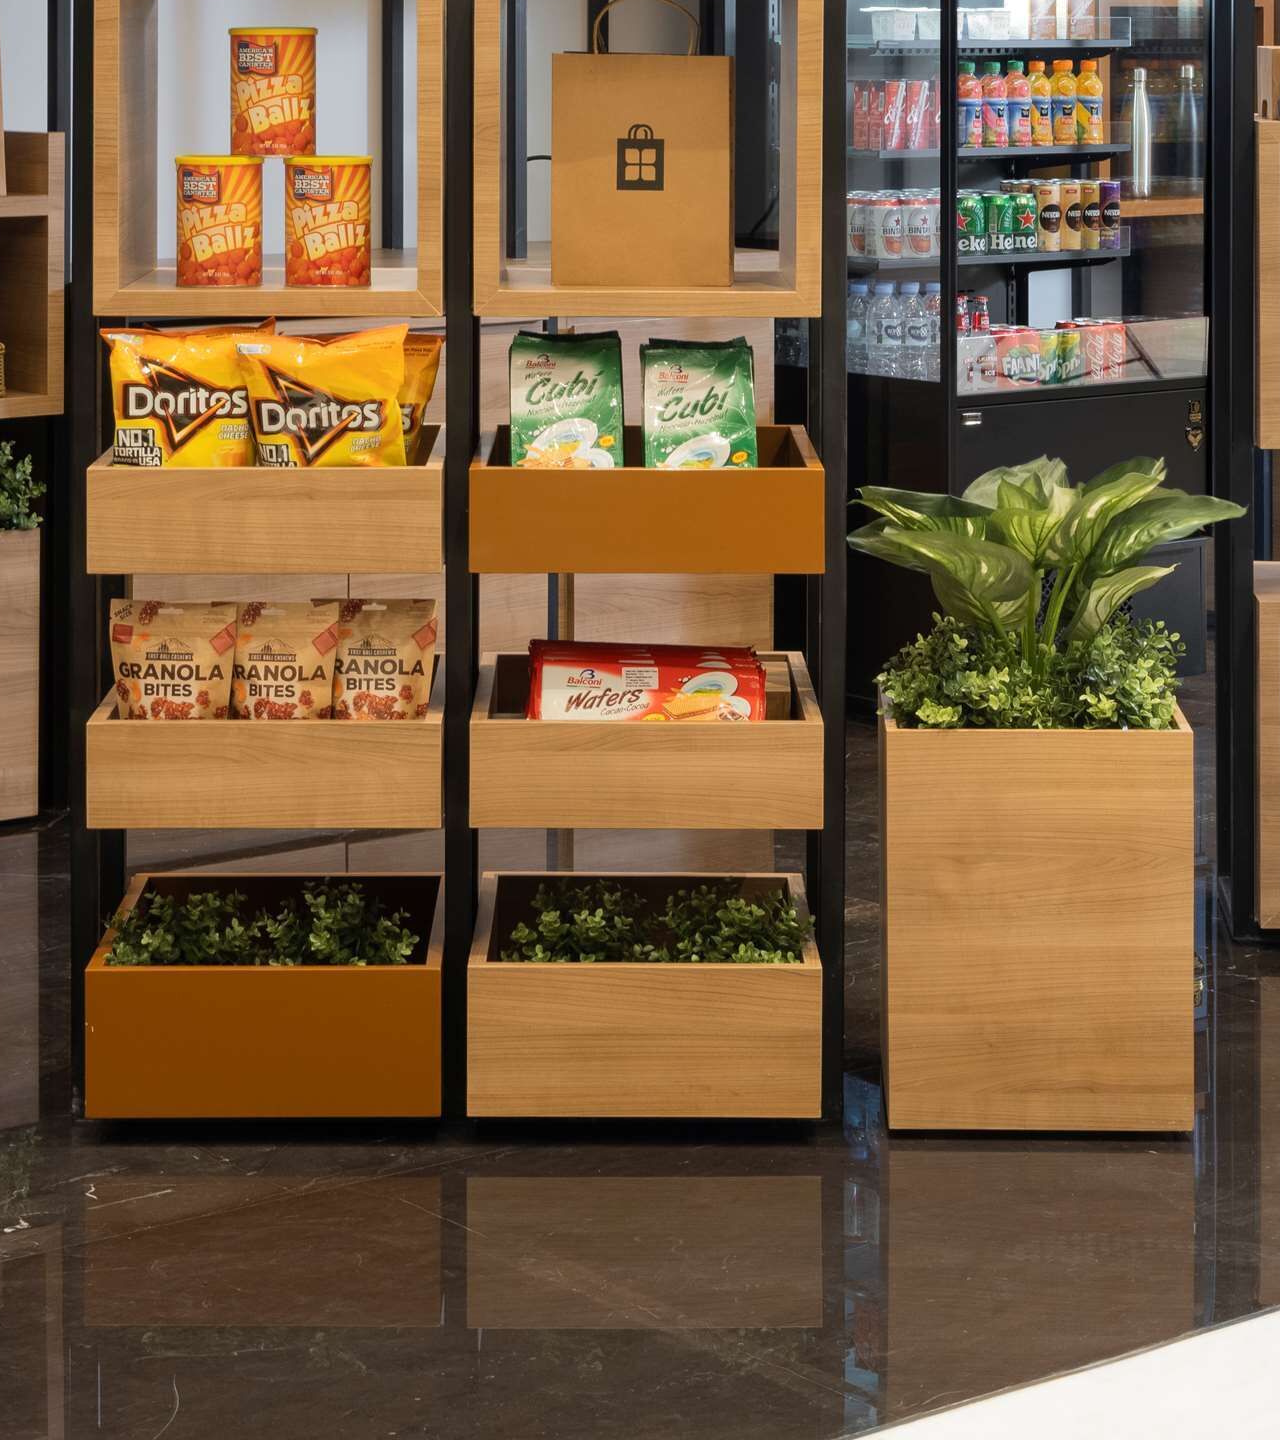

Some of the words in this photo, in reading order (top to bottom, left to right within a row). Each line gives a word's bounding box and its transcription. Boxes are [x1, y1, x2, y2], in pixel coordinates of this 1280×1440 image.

[238, 47, 273, 55] AMERICA'S
[238, 53, 274, 62] BEST
[236, 74, 303, 106] Pizza
[247, 98, 311, 134] Ballz
[183, 181, 217, 191] BEST
[294, 179, 329, 189] BEST
[182, 202, 247, 234] Pizza
[292, 201, 359, 234] Pizza
[192, 225, 257, 262] Ballz
[304, 224, 366, 261] Ballz
[526, 370, 605, 406] Cubi
[127, 386, 248, 417] Doritos
[261, 402, 381, 433] Doritos
[118, 429, 154, 447] NO.1
[114, 447, 161, 458] TORTILLA
[138, 457, 161, 466] USA
[260, 444, 289, 463] NO.1
[120, 663, 224, 681] GRANOLA
[233, 664, 327, 682] RANOLA
[334, 658, 425, 677] RANOLA
[144, 683, 193, 697] BITES
[346, 678, 396, 691] BITES
[567, 676, 602, 686] Balconi
[249, 684, 296, 698] BITES
[565, 688, 644, 713] Wafers
